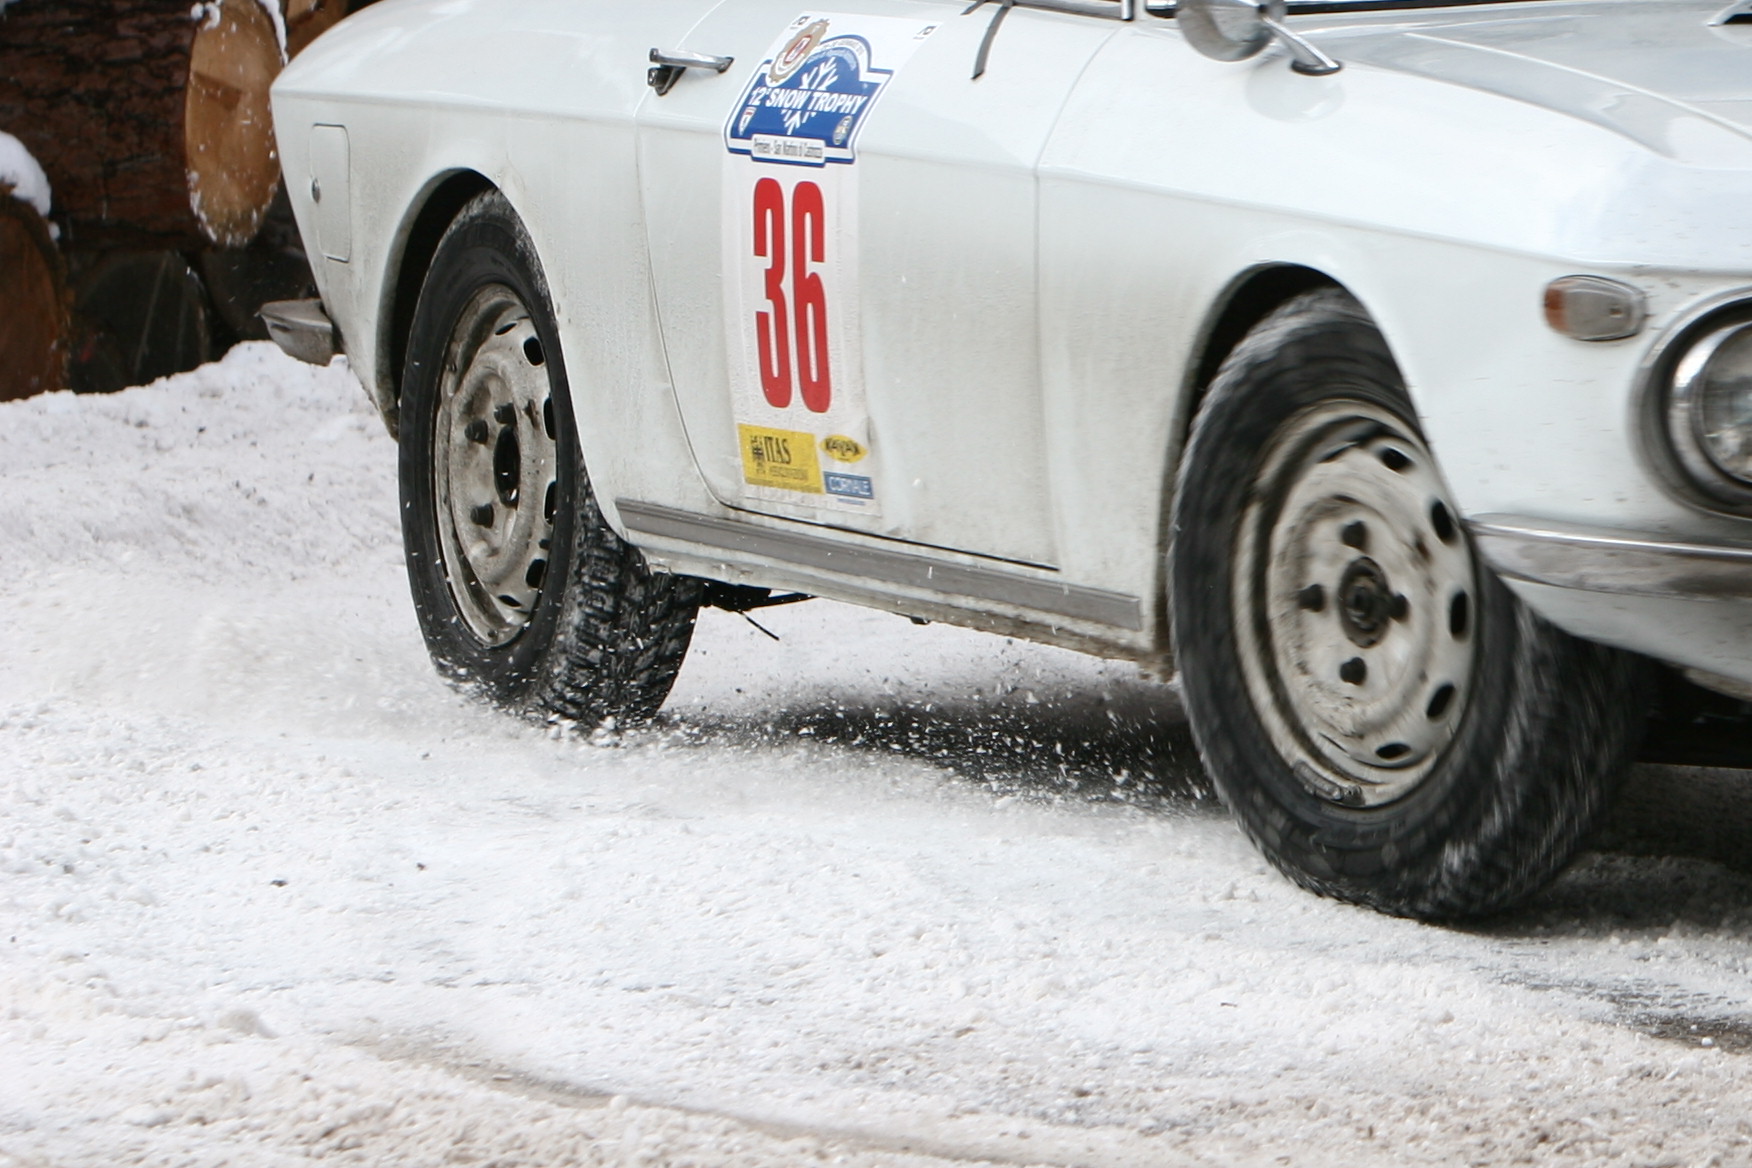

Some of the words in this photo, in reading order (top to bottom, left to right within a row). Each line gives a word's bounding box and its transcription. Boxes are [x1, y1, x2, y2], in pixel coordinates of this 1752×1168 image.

[765, 89, 808, 111] SNOW
[807, 92, 868, 115] TROPHY
[753, 177, 832, 414] 36
[764, 436, 792, 464] ITAS
